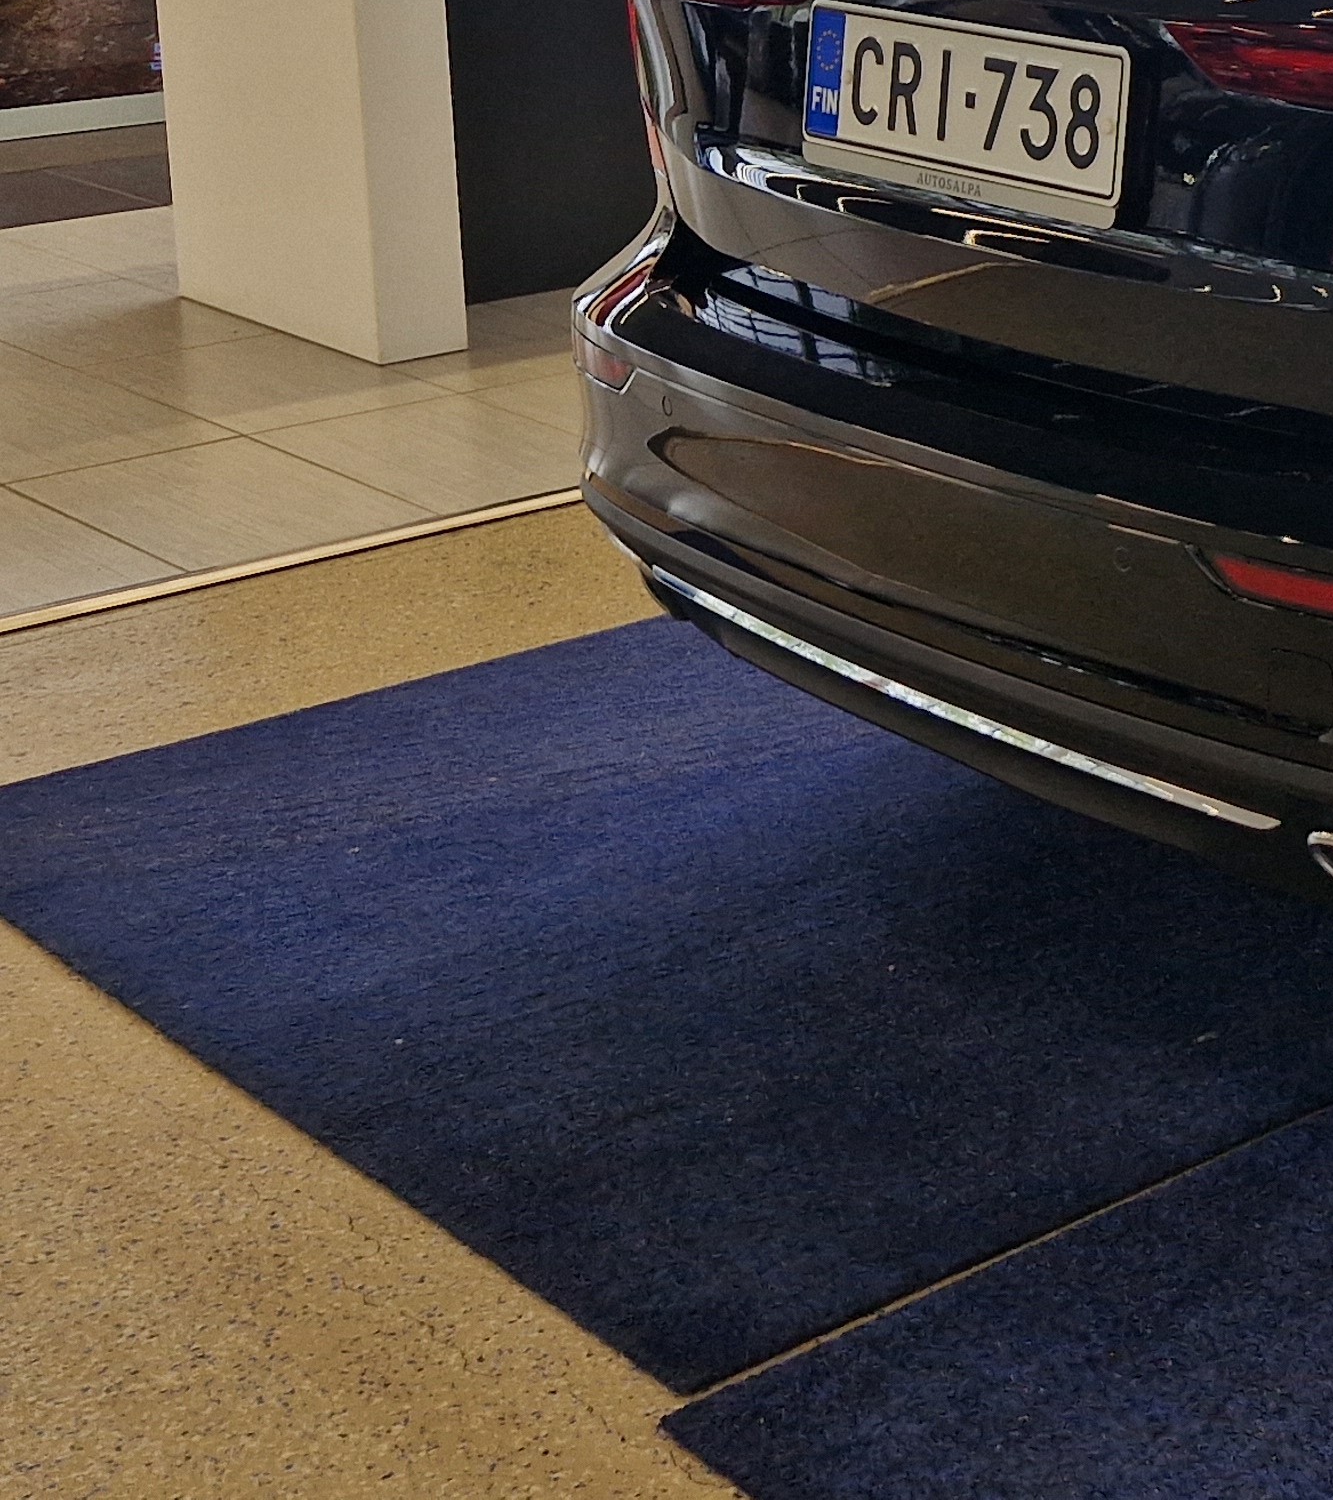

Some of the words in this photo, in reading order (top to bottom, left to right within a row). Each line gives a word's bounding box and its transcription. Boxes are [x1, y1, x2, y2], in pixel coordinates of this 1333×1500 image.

[811, 85, 839, 116] FIN
[850, 35, 1102, 170] CRI-738
[916, 172, 982, 198] AUTOSALPA
